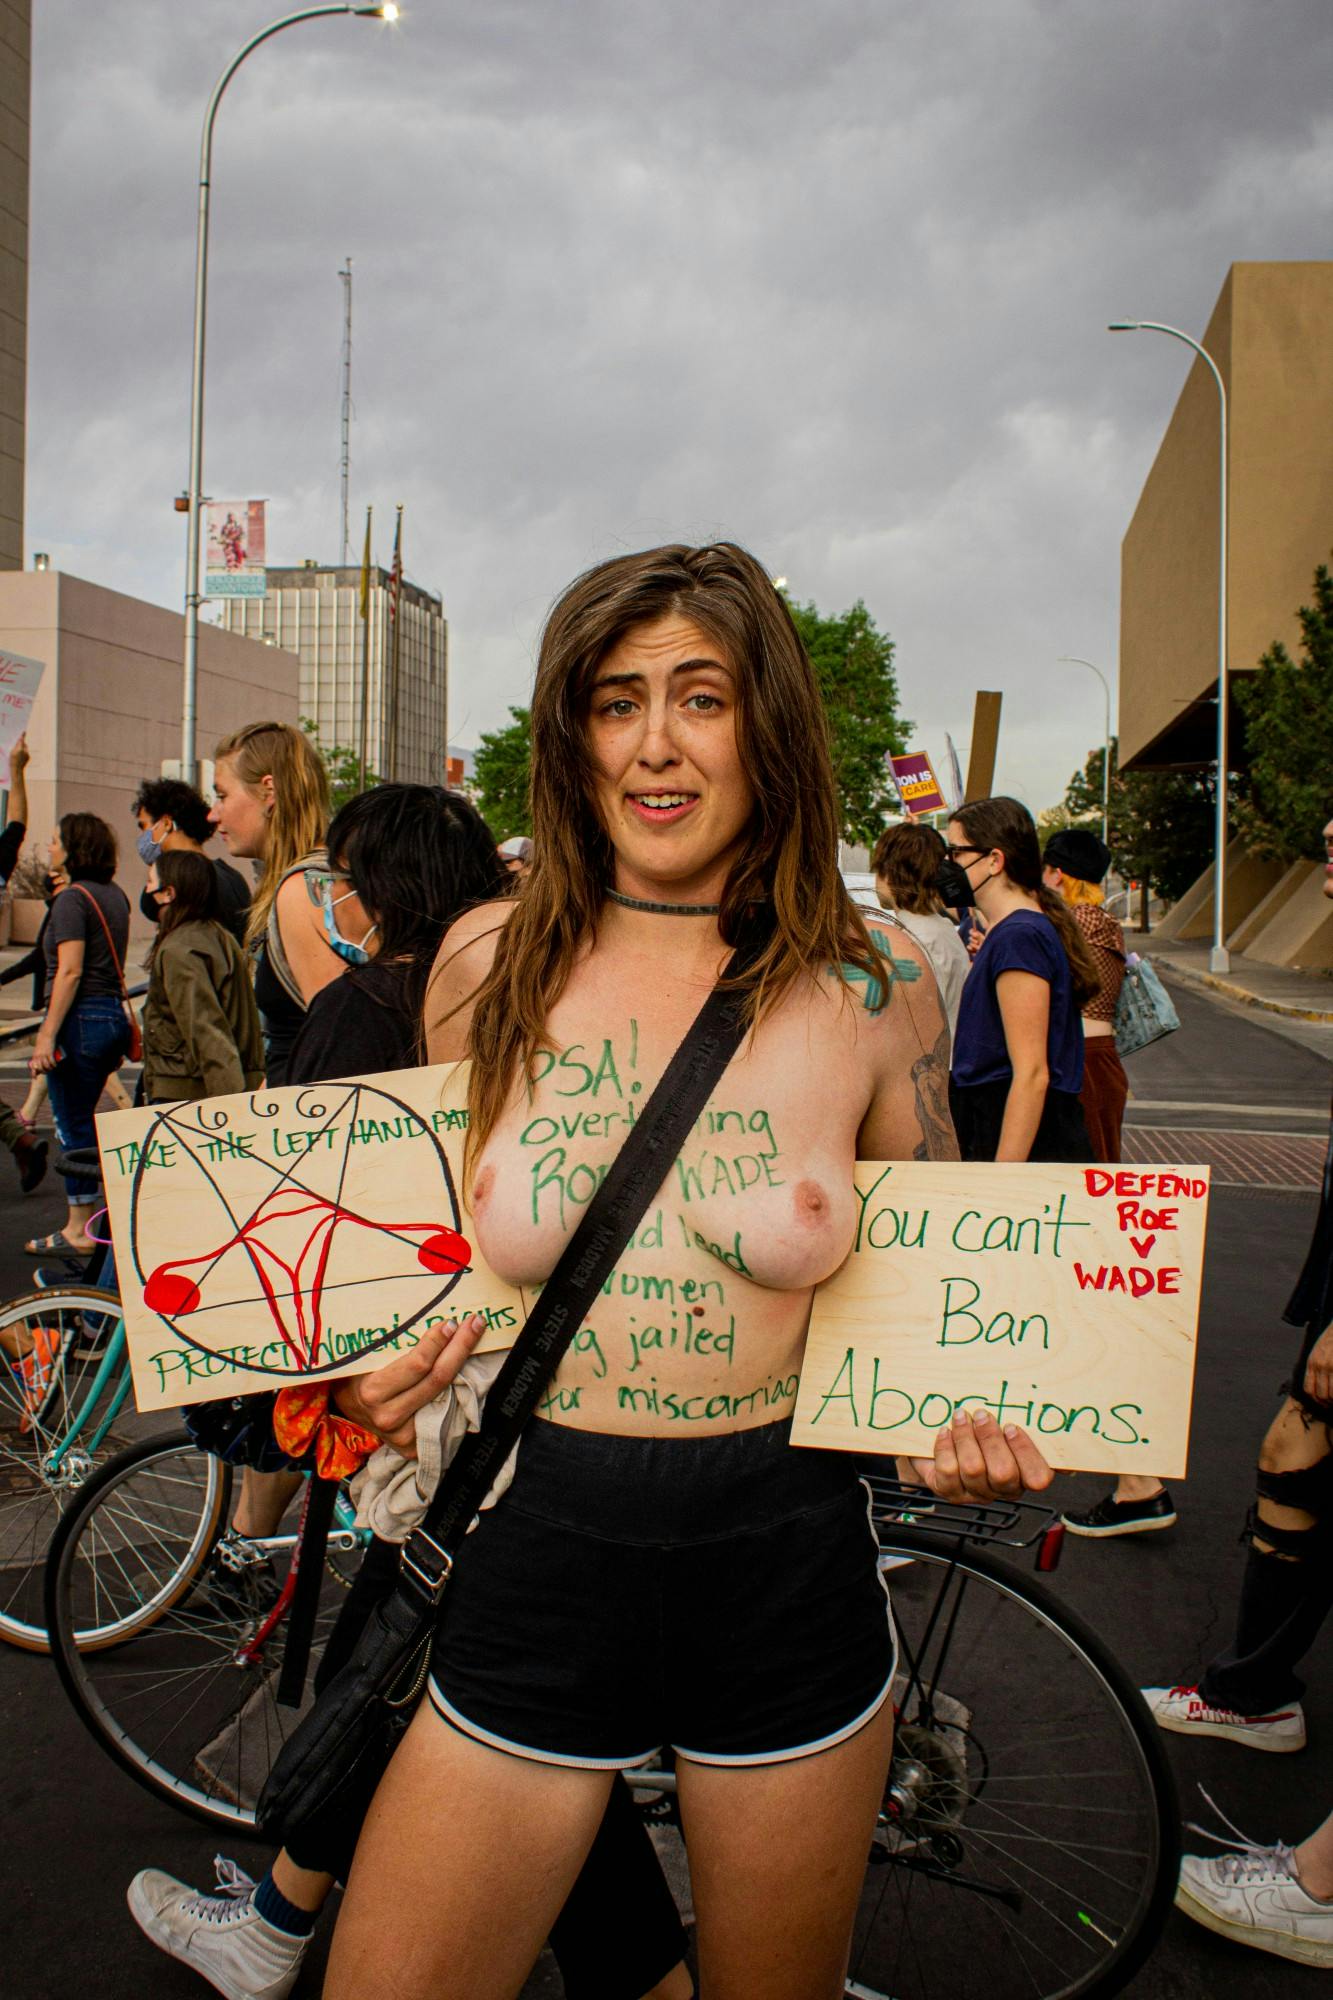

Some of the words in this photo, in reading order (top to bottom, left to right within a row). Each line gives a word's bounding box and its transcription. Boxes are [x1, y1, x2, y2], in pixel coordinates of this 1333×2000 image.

[905, 781, 937, 796] CARE
[919, 771, 932, 781] IS
[523, 1018, 643, 1106] PSA!
[104, 1141, 178, 1176] TAKE
[198, 1129, 256, 1163] THE
[273, 1126, 340, 1158] LEFT
[350, 1114, 425, 1149] HAND
[675, 1151, 787, 1202] WADE
[1083, 1168, 1208, 1199] DEFEND
[853, 1166, 930, 1253] You
[952, 1194, 1092, 1258] can't
[1116, 1200, 1179, 1232] ROE
[569, 1223, 616, 1289] MADDEN
[1073, 1262, 1182, 1298] WADE
[535, 1303, 569, 1354] STEVE
[936, 1277, 1049, 1349] Ban
[148, 1340, 298, 1393] PROTECT
[627, 1310, 736, 1373] jailed
[500, 1355, 541, 1418] MADDEN
[811, 1347, 1150, 1444] Abortions.
[467, 1435, 499, 1480] STEVE
